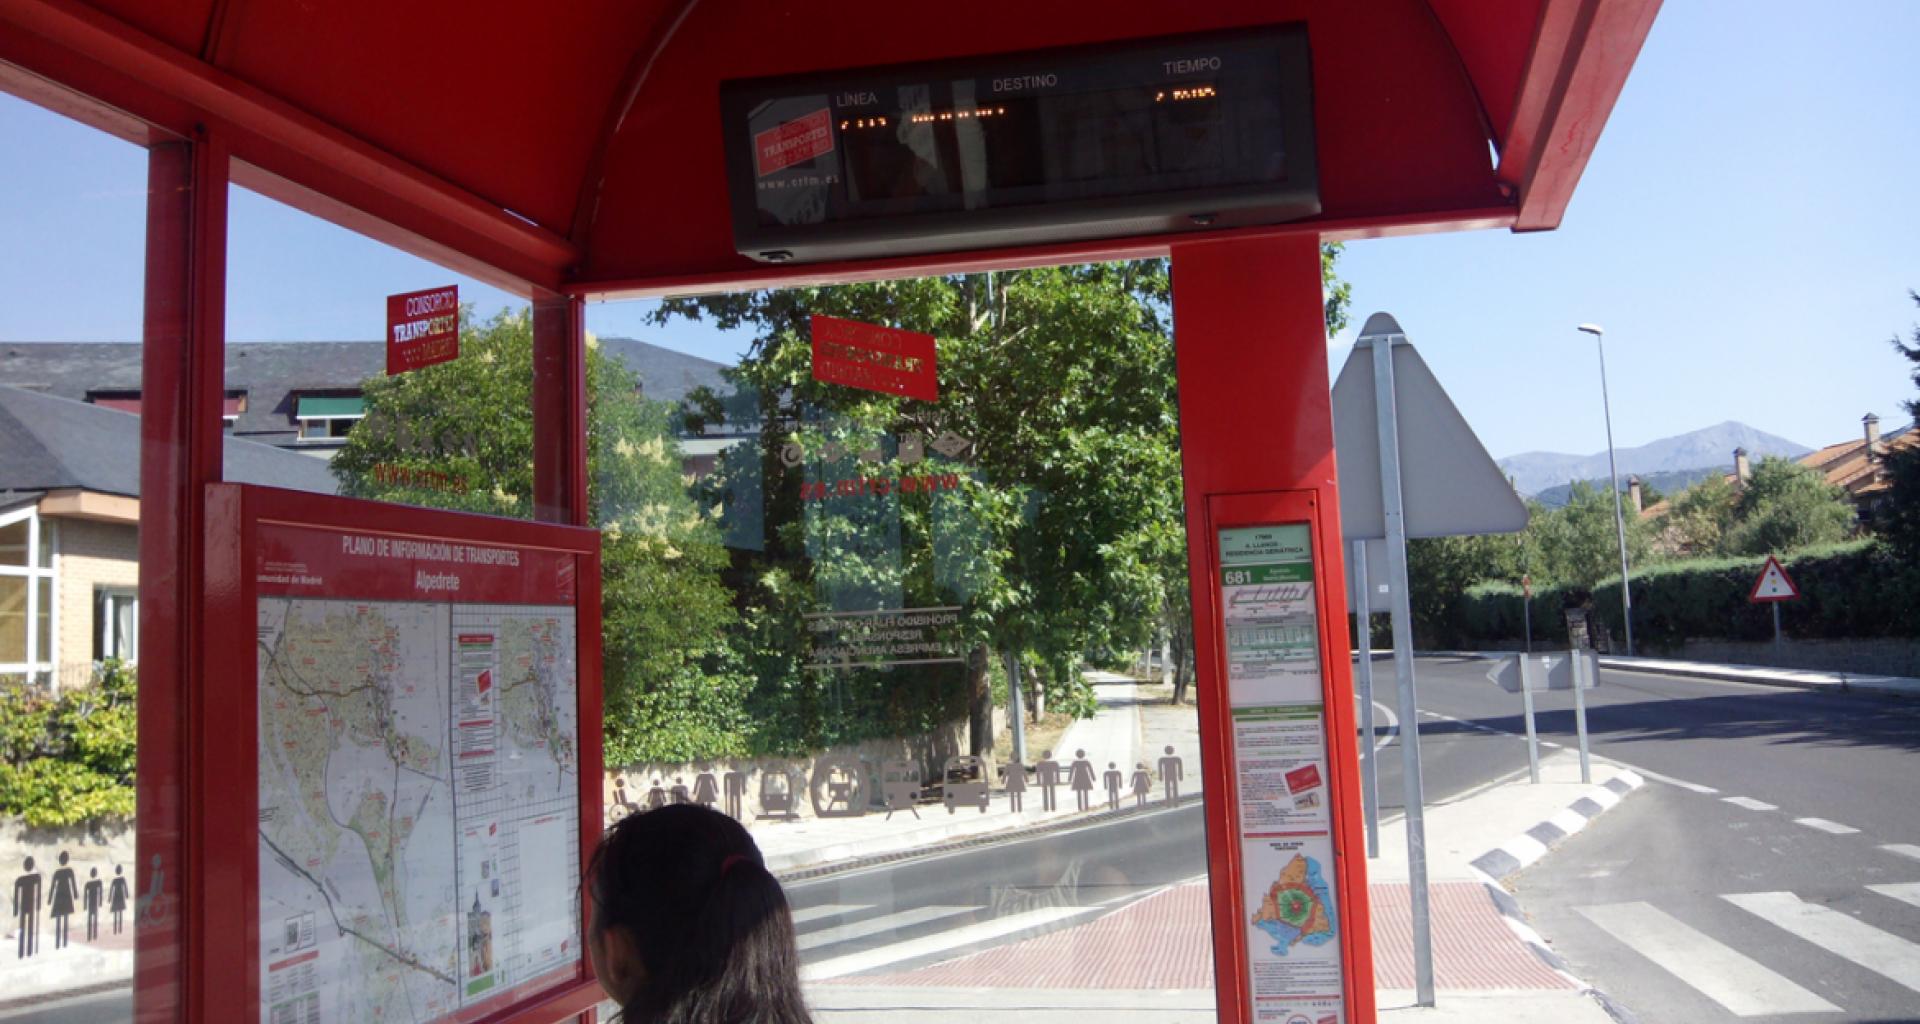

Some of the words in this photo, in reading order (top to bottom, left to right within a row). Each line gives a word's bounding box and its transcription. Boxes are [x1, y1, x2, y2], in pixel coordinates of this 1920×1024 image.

[1163, 56, 1222, 75] TIEMPO
[992, 73, 1058, 92] DESTINO
[836, 91, 879, 107] LÍNEA
[342, 535, 376, 557] PLANO
[378, 538, 390, 557] DE
[392, 539, 451, 562] INFORMACIÓN
[453, 545, 465, 563] DE
[466, 546, 520, 567] TRANSPORTES
[415, 568, 460, 592] Alpedrete
[1225, 570, 1252, 585] 681
